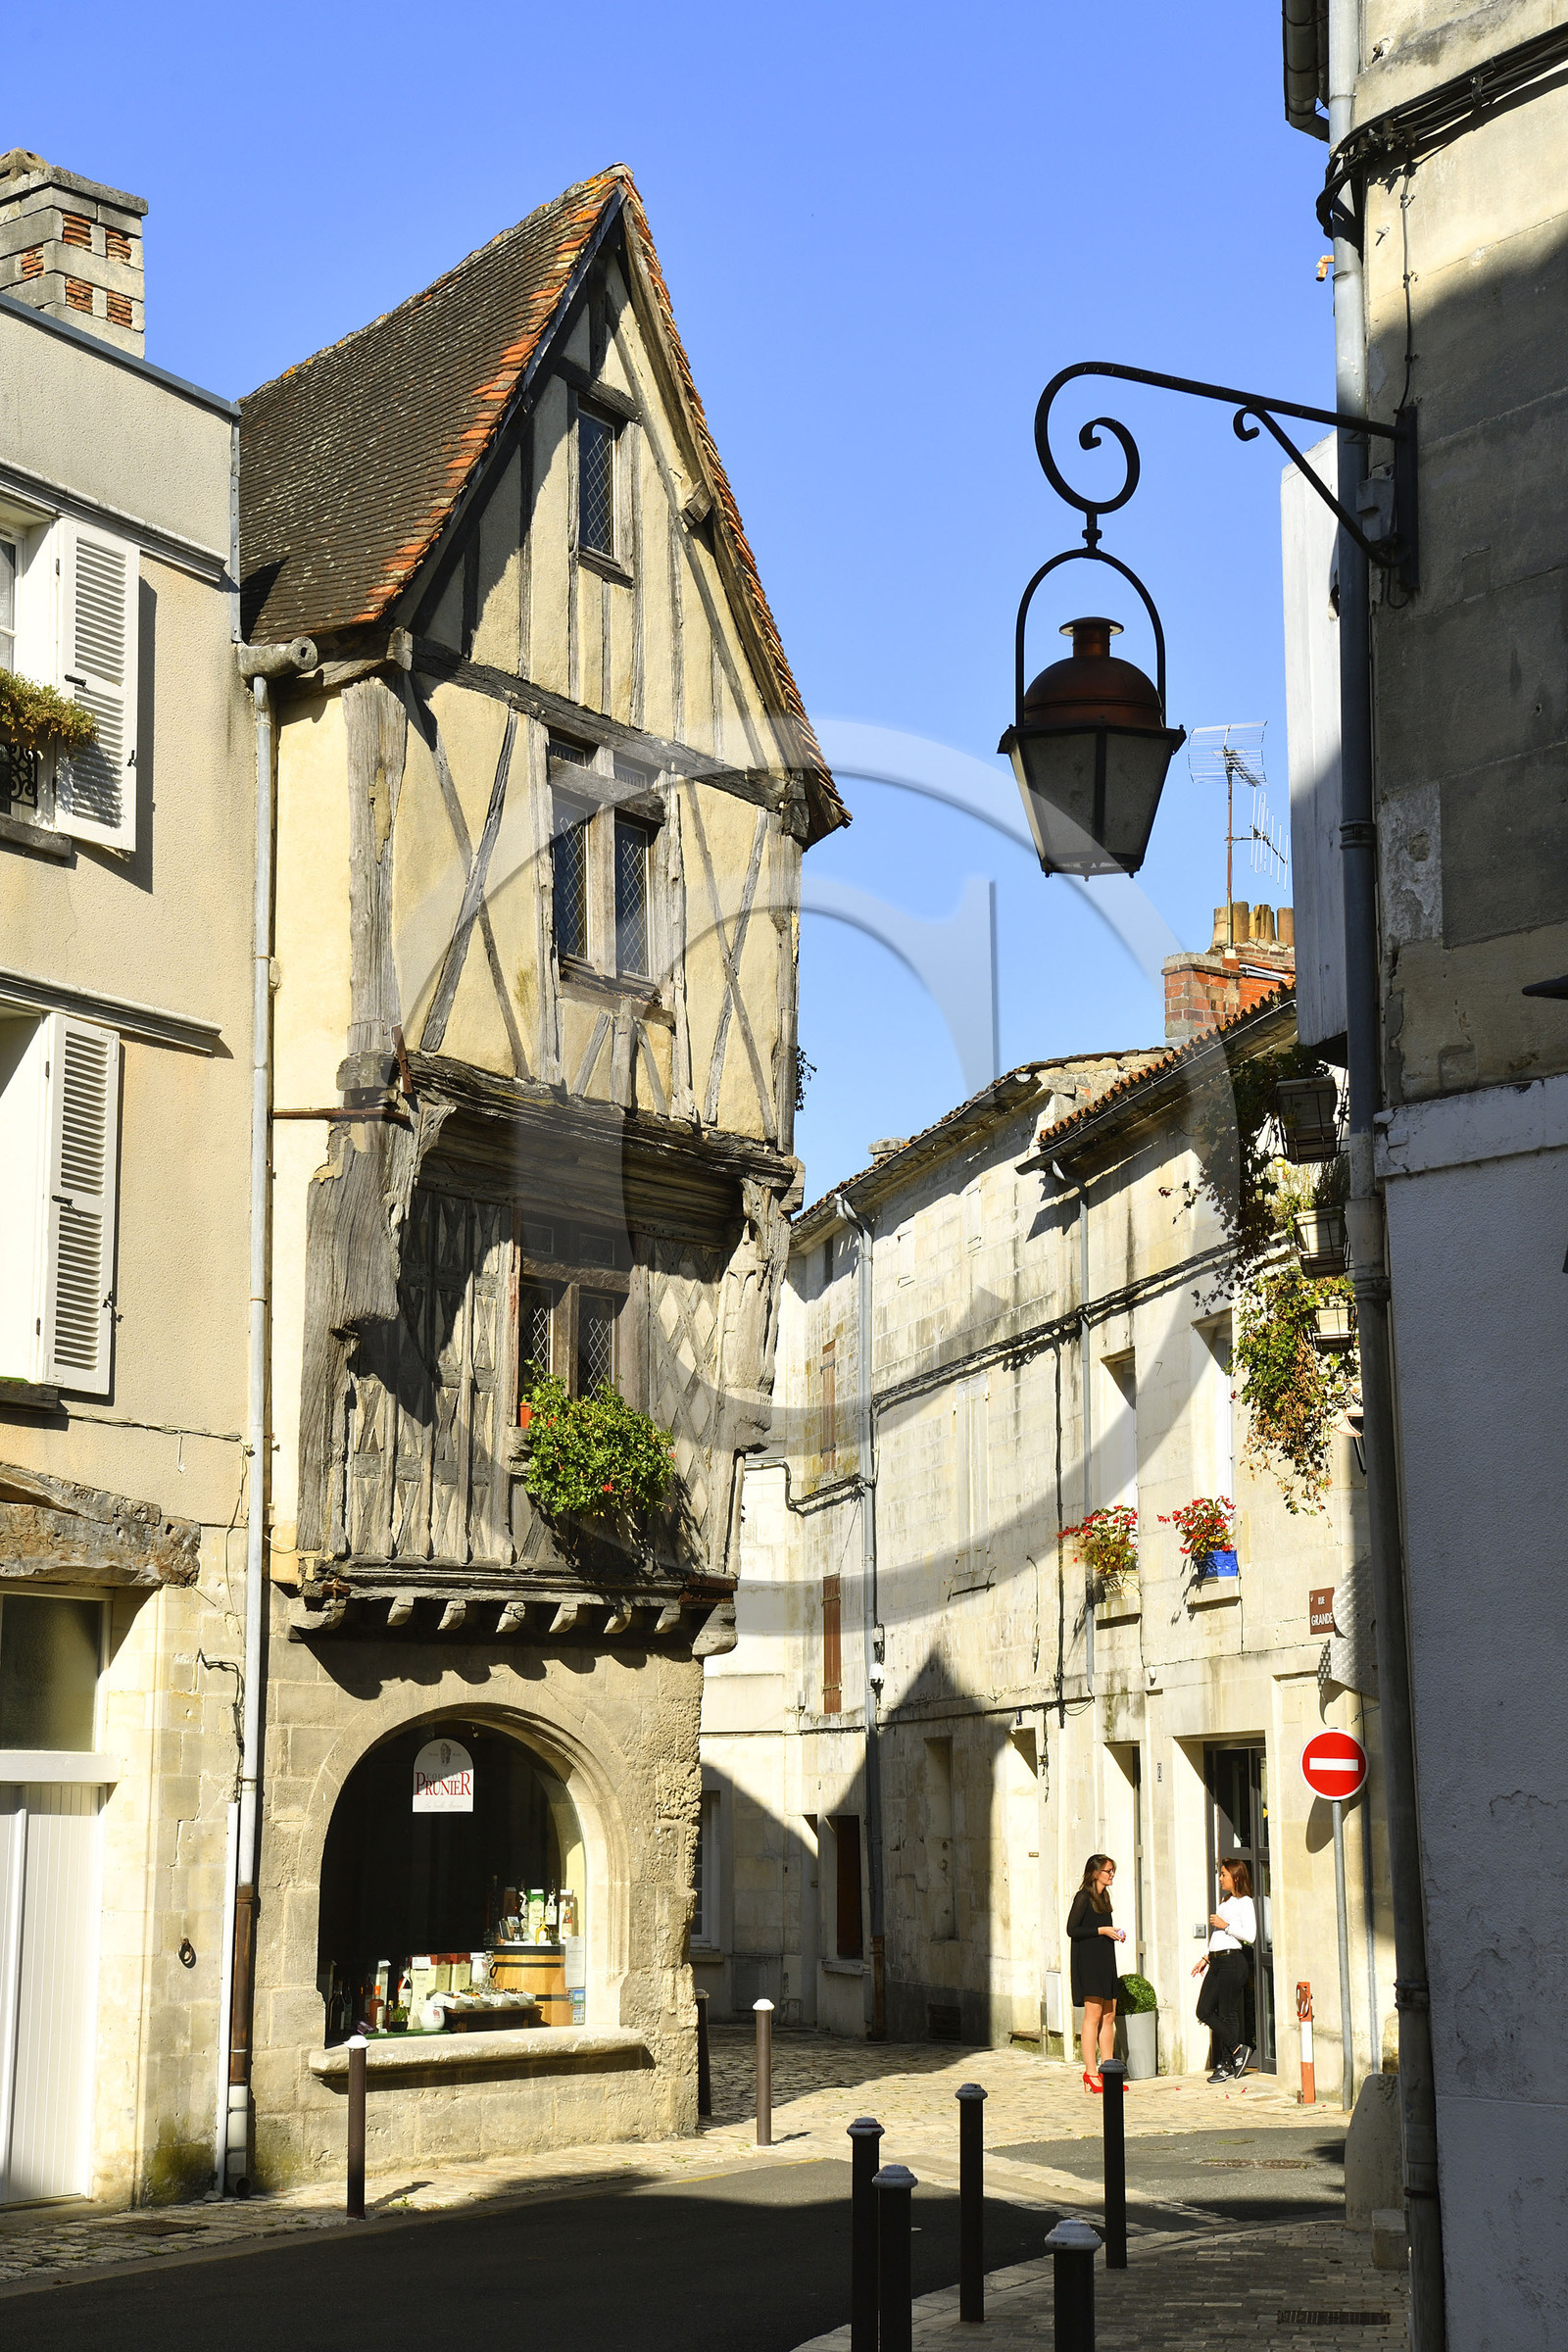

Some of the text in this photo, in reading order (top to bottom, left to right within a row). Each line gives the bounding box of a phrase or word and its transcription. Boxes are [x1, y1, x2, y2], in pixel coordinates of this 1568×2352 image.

[1317, 1595, 1326, 1605] RUE
[1311, 1612, 1334, 1627] GRANDE
[415, 1772, 471, 1795] PRUNIER
